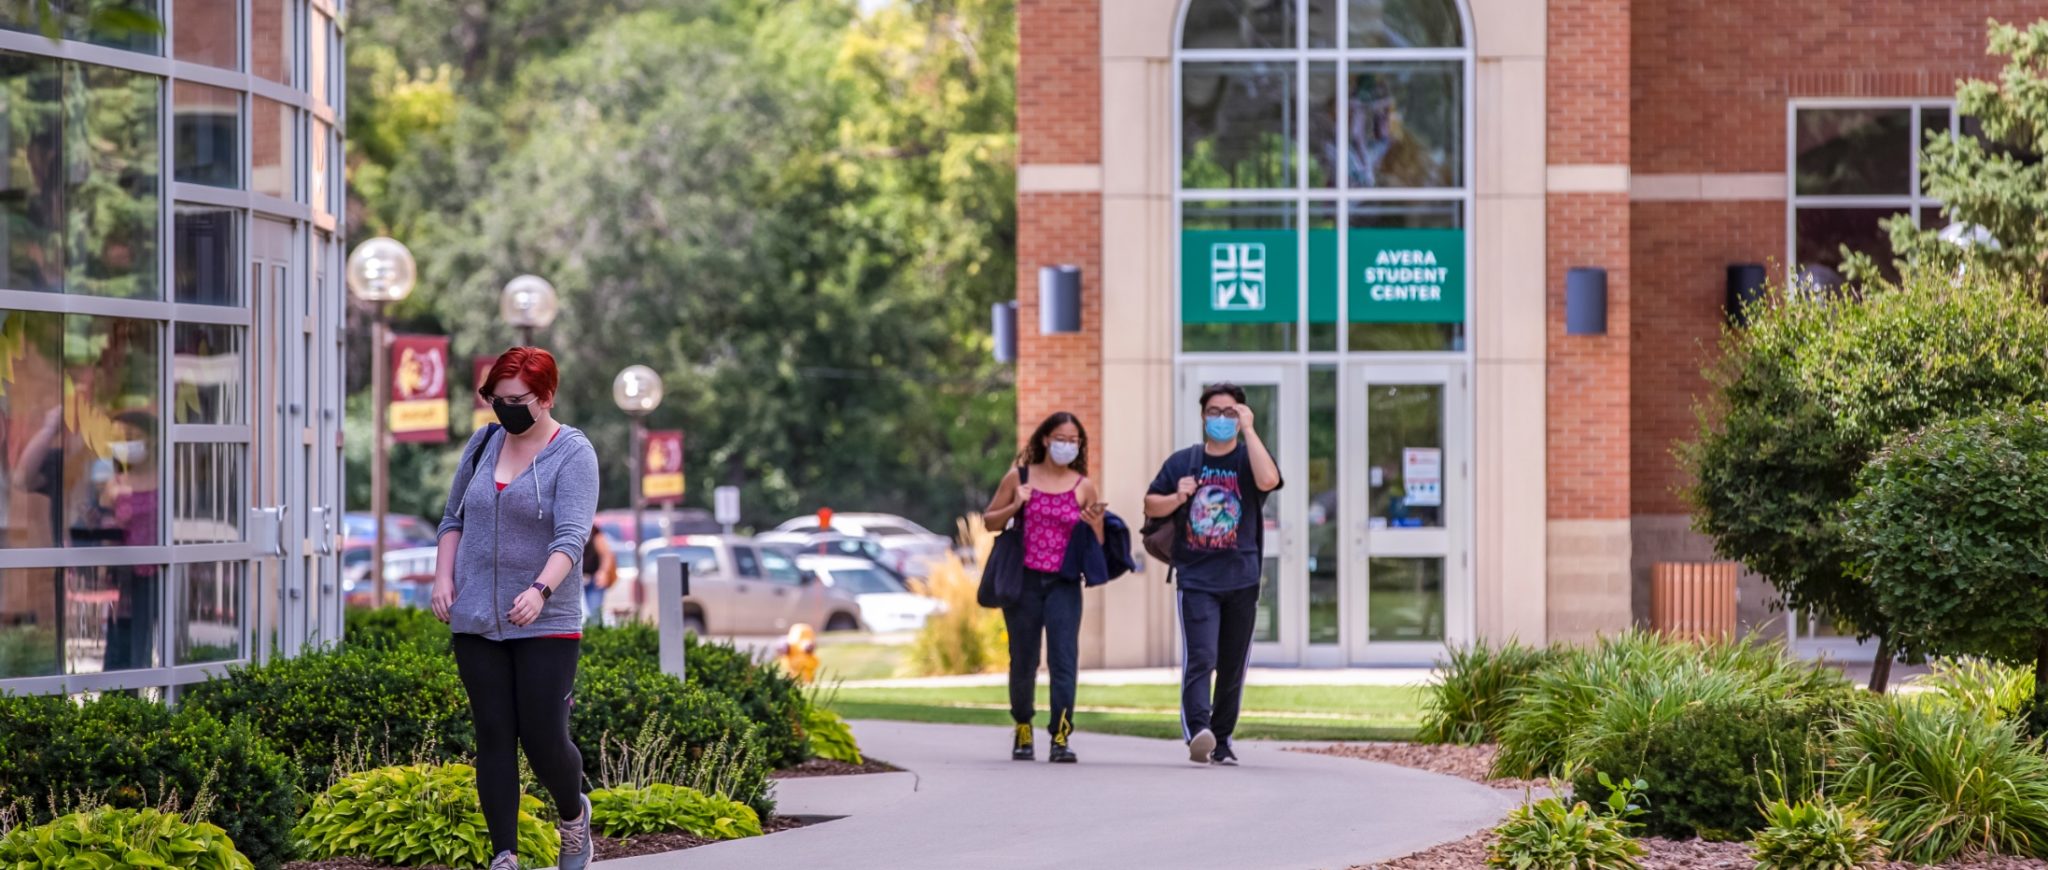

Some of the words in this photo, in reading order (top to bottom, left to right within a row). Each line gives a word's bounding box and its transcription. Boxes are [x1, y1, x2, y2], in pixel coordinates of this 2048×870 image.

[1375, 249, 1437, 265] AVERA
[1364, 267, 1448, 283] STUDENT
[1370, 285, 1441, 301] CENTER
